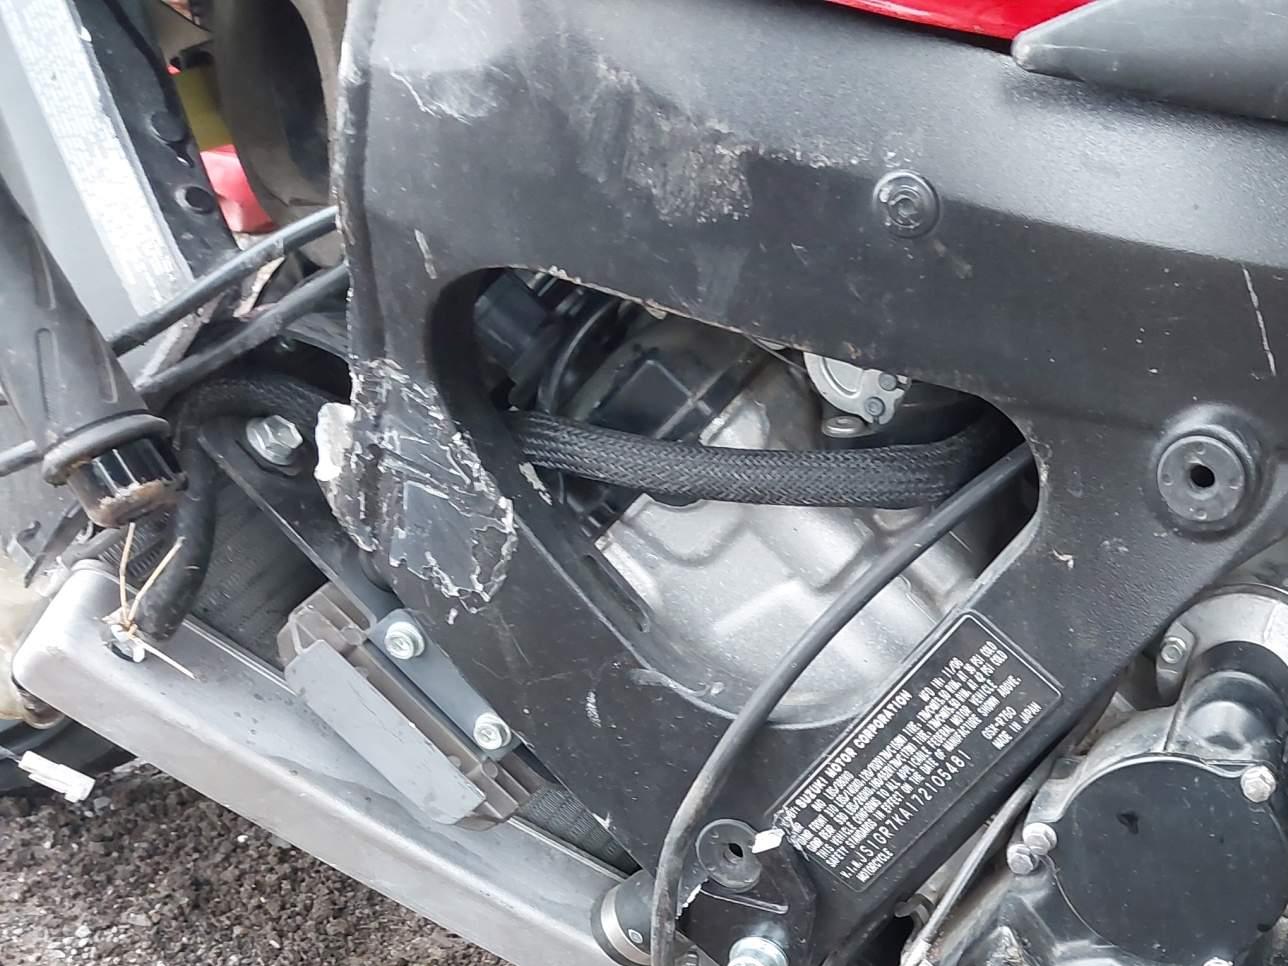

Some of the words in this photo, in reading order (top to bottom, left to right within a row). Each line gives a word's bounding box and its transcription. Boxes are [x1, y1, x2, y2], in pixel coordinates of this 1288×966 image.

[968, 652, 986, 668] PSI
[978, 639, 999, 659] COLD
[979, 662, 996, 677] PSI
[989, 649, 1009, 667] COLD
[976, 694, 1002, 717] SHOWN
[940, 713, 983, 752] MANUFACTURE
[980, 704, 1018, 739] GSX-R750
[990, 729, 1013, 749] MADE
[1007, 719, 1023, 733] IN
[1016, 700, 1043, 724] JAPAN
[793, 775, 829, 809] SUZUKI
[823, 746, 858, 778] MOTOR
[851, 689, 913, 749] CORPORATION
[932, 748, 948, 760] OF
[815, 842, 835, 860] THIS
[828, 821, 857, 846] VEHICLE
[850, 795, 882, 824] CONFORMS
[875, 787, 890, 799] TO
[884, 776, 901, 790] ALL
[895, 745, 932, 779] APPLICABLE
[925, 722, 955, 749] FEDERAL
[948, 704, 973, 726] MOTOR
[967, 678, 999, 707] VEHICLE
[907, 771, 925, 785] THE
[918, 757, 939, 774] DATE
[879, 791, 905, 813] EFFECT
[899, 782, 914, 794] ON
[872, 809, 887, 820] IN
[844, 818, 878, 848] STANDARDS
[824, 845, 850, 868] SAFETY
[855, 847, 894, 882] MOTORCYCLE
